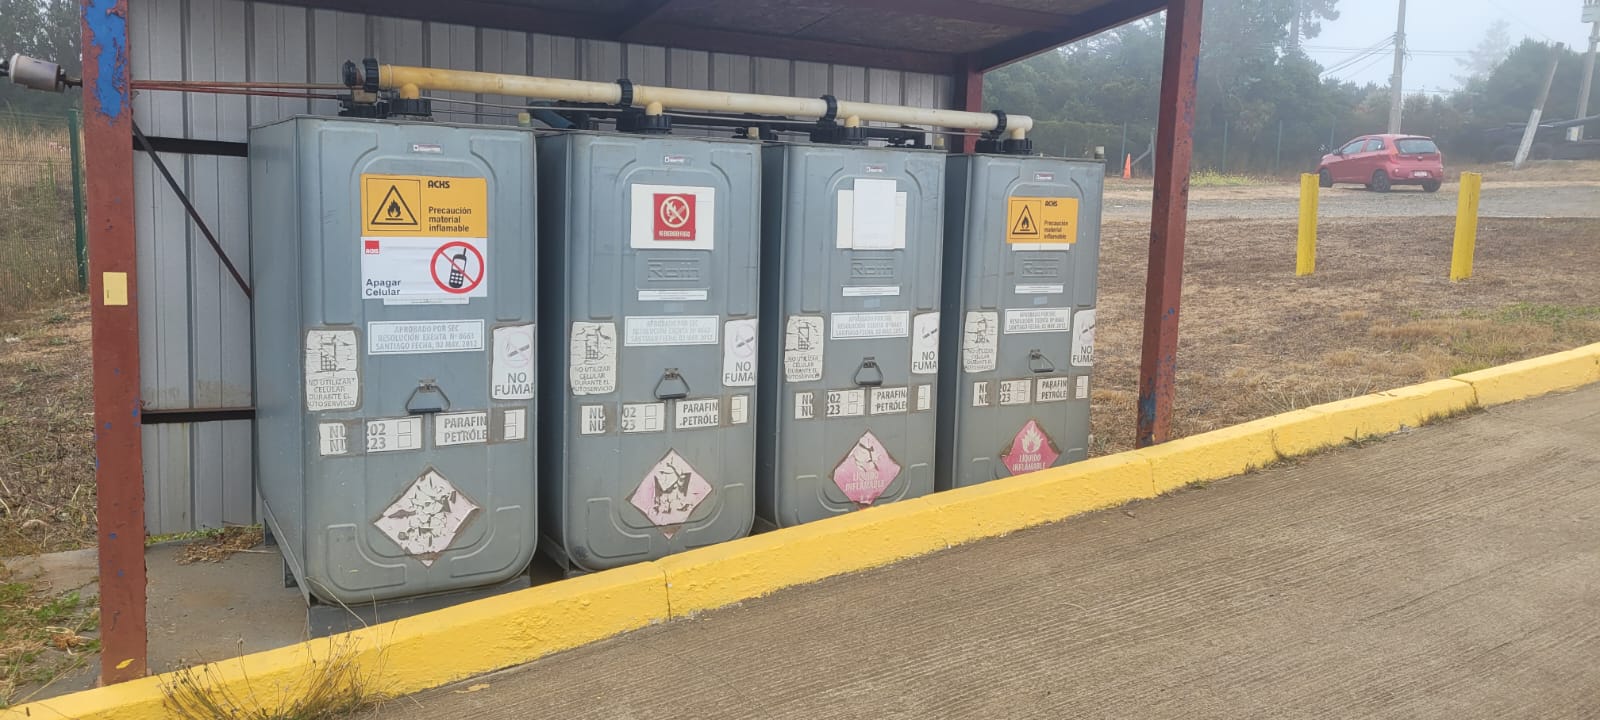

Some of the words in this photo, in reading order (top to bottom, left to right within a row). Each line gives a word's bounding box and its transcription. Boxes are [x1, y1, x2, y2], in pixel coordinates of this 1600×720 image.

[428, 180, 450, 188] ACHS
[429, 206, 472, 215] Precaución
[429, 224, 469, 232] inflamable
[366, 279, 401, 287] Apagar
[376, 342, 410, 350] SANTIAGO
[1081, 345, 1092, 354] NO
[922, 351, 935, 360] NO
[735, 361, 751, 372] NO
[507, 372, 527, 383] NO
[725, 372, 756, 382] FUMA
[1000, 383, 1011, 392] 02
[1000, 393, 1011, 403] 23
[683, 402, 718, 414] PARAFIN
[367, 423, 386, 436] 02
[367, 436, 386, 449] 23
